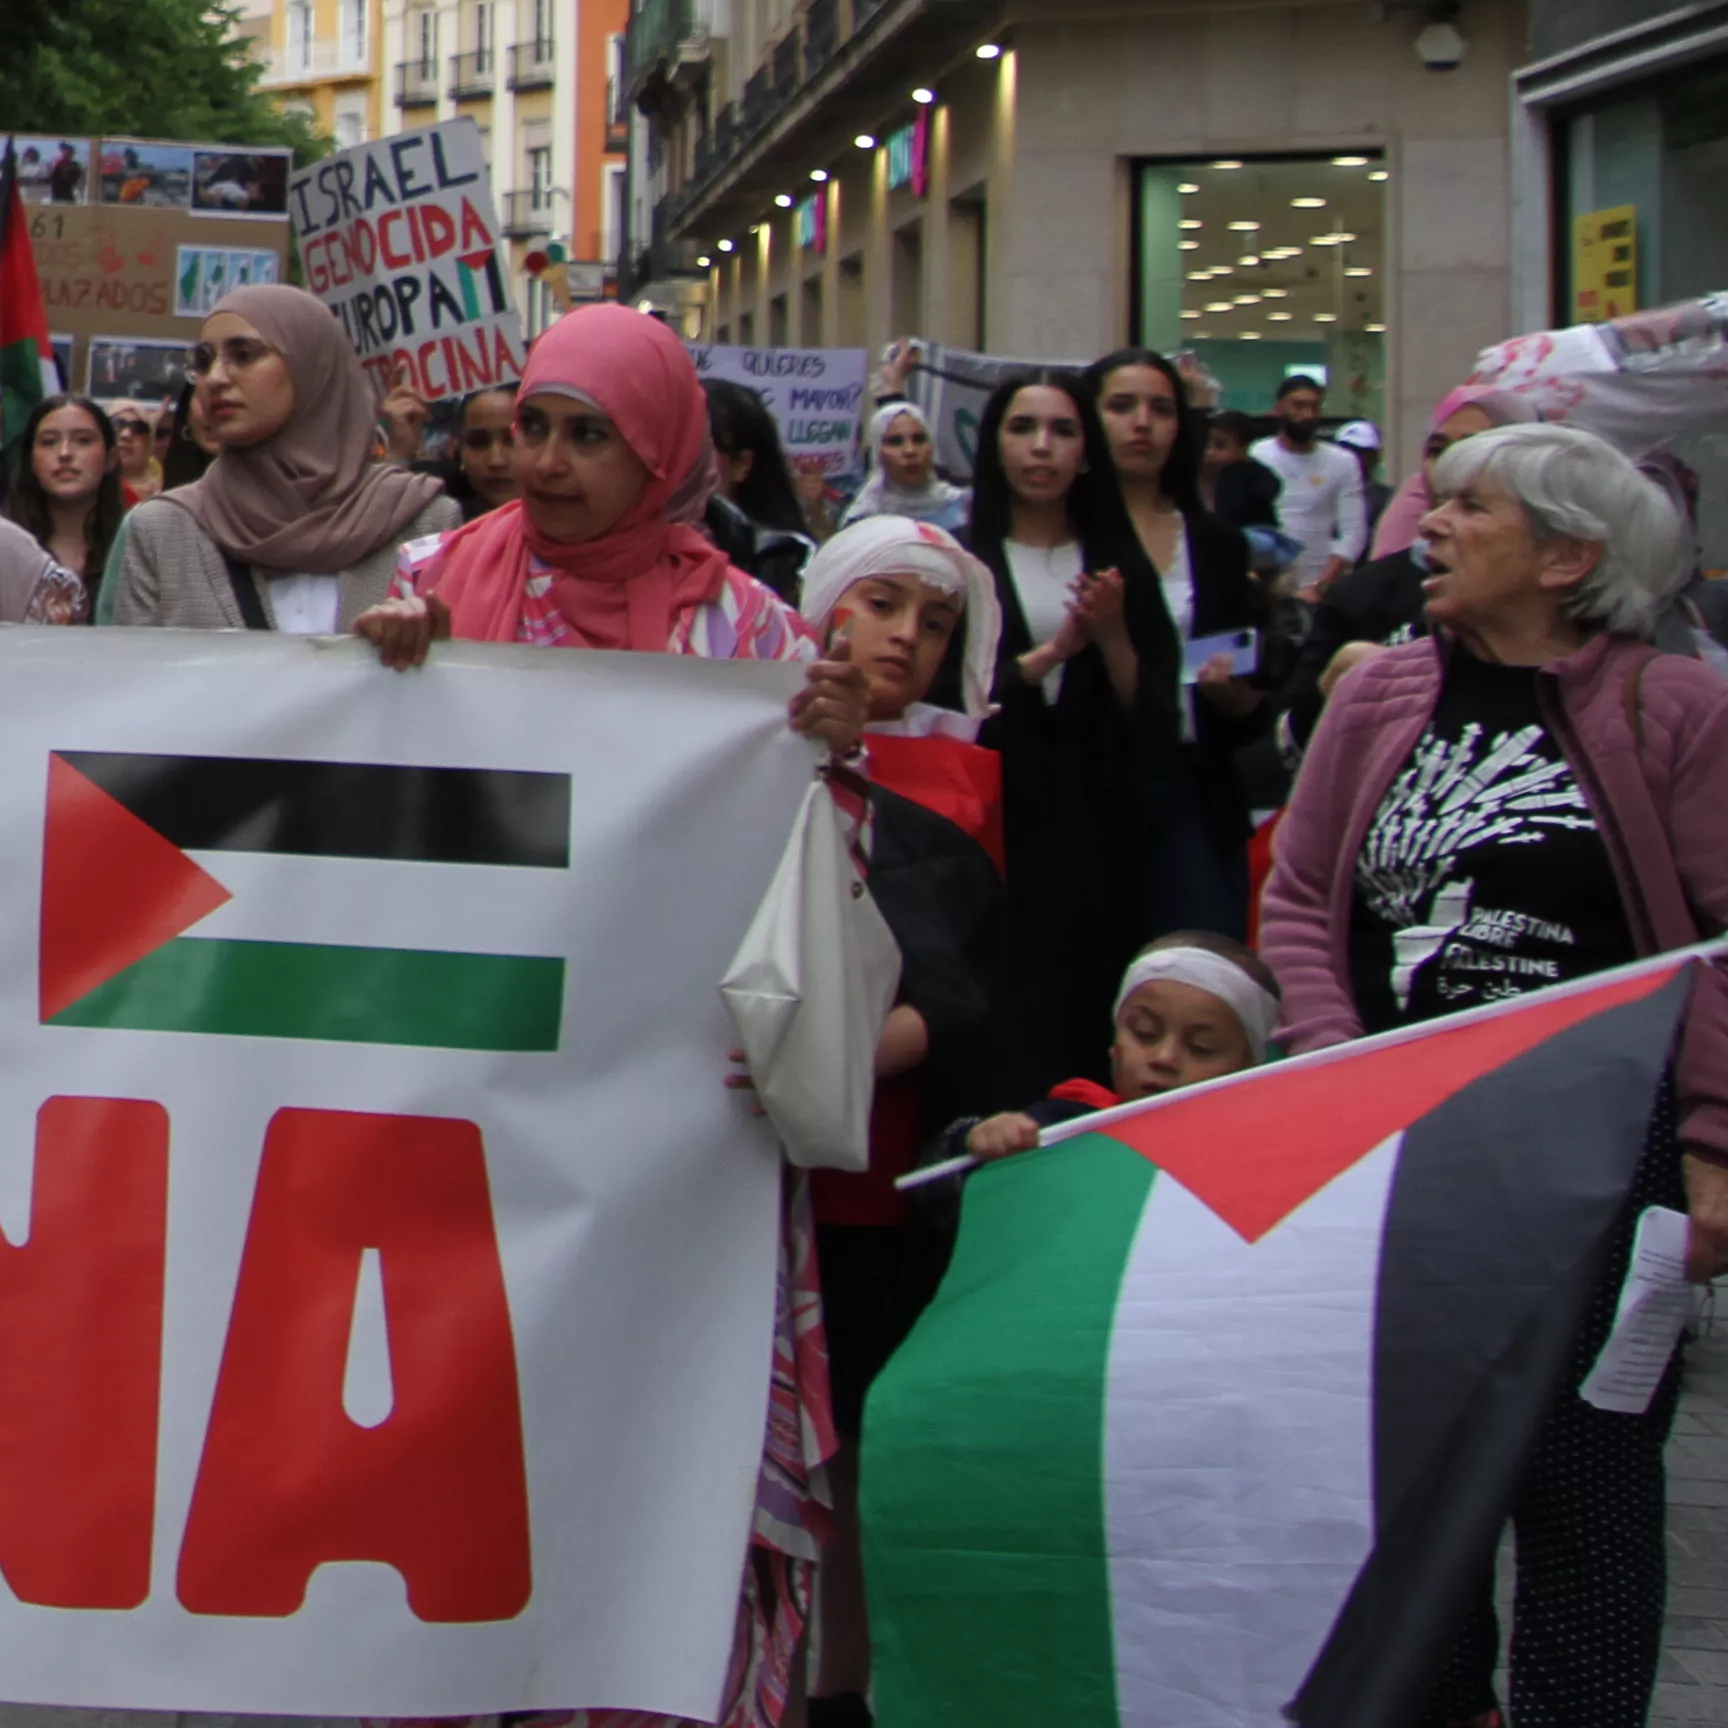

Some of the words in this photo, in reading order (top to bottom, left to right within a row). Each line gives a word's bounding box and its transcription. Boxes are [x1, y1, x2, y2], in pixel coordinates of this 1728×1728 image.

[291, 132, 479, 236] ISRAEL
[304, 195, 493, 295] GENOCIDA
[361, 324, 524, 400] TROCINA
[1458, 924, 1519, 950] LIBRE
[1471, 907, 1577, 946] PALESTINA
